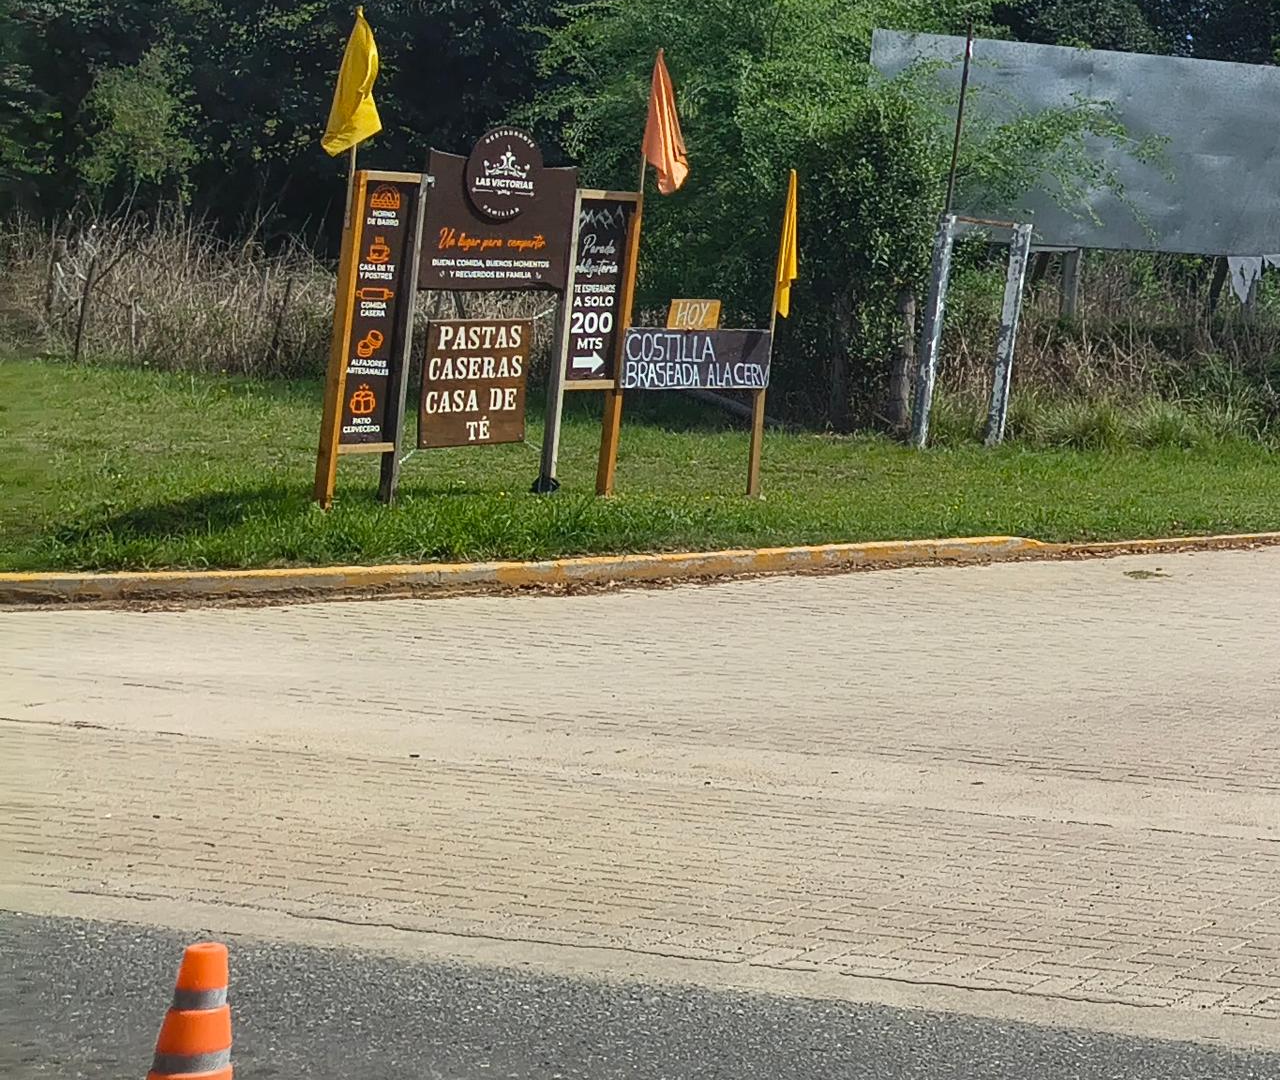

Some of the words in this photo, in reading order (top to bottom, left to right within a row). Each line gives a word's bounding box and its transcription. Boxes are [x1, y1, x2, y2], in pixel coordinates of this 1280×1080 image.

[475, 177, 491, 186] LAS
[491, 178, 534, 190] VICTORIAS
[438, 227, 455, 248] Un
[359, 263, 376, 271] CASA
[377, 264, 386, 272] DE
[513, 260, 550, 268] MOMENTOS
[365, 272, 393, 280] POSTRES
[506, 271, 531, 279] FAMILIA
[574, 284, 582, 293] TE
[582, 284, 616, 293] ESPERAMOS
[574, 296, 582, 307] A
[584, 296, 614, 307] SOLO
[675, 302, 710, 326] HOY
[571, 312, 613, 334] 200
[437, 325, 522, 350] PASTAS
[576, 338, 603, 350] MTS
[626, 333, 716, 362] COSTILLA
[350, 359, 386, 368] ALFAJORES
[429, 355, 523, 380] CASERAS
[346, 367, 389, 376] ARTESANALES
[625, 362, 700, 388] BRASEADA
[425, 389, 479, 414] CASA
[489, 388, 517, 410] DE
[466, 415, 490, 441] TÉ
